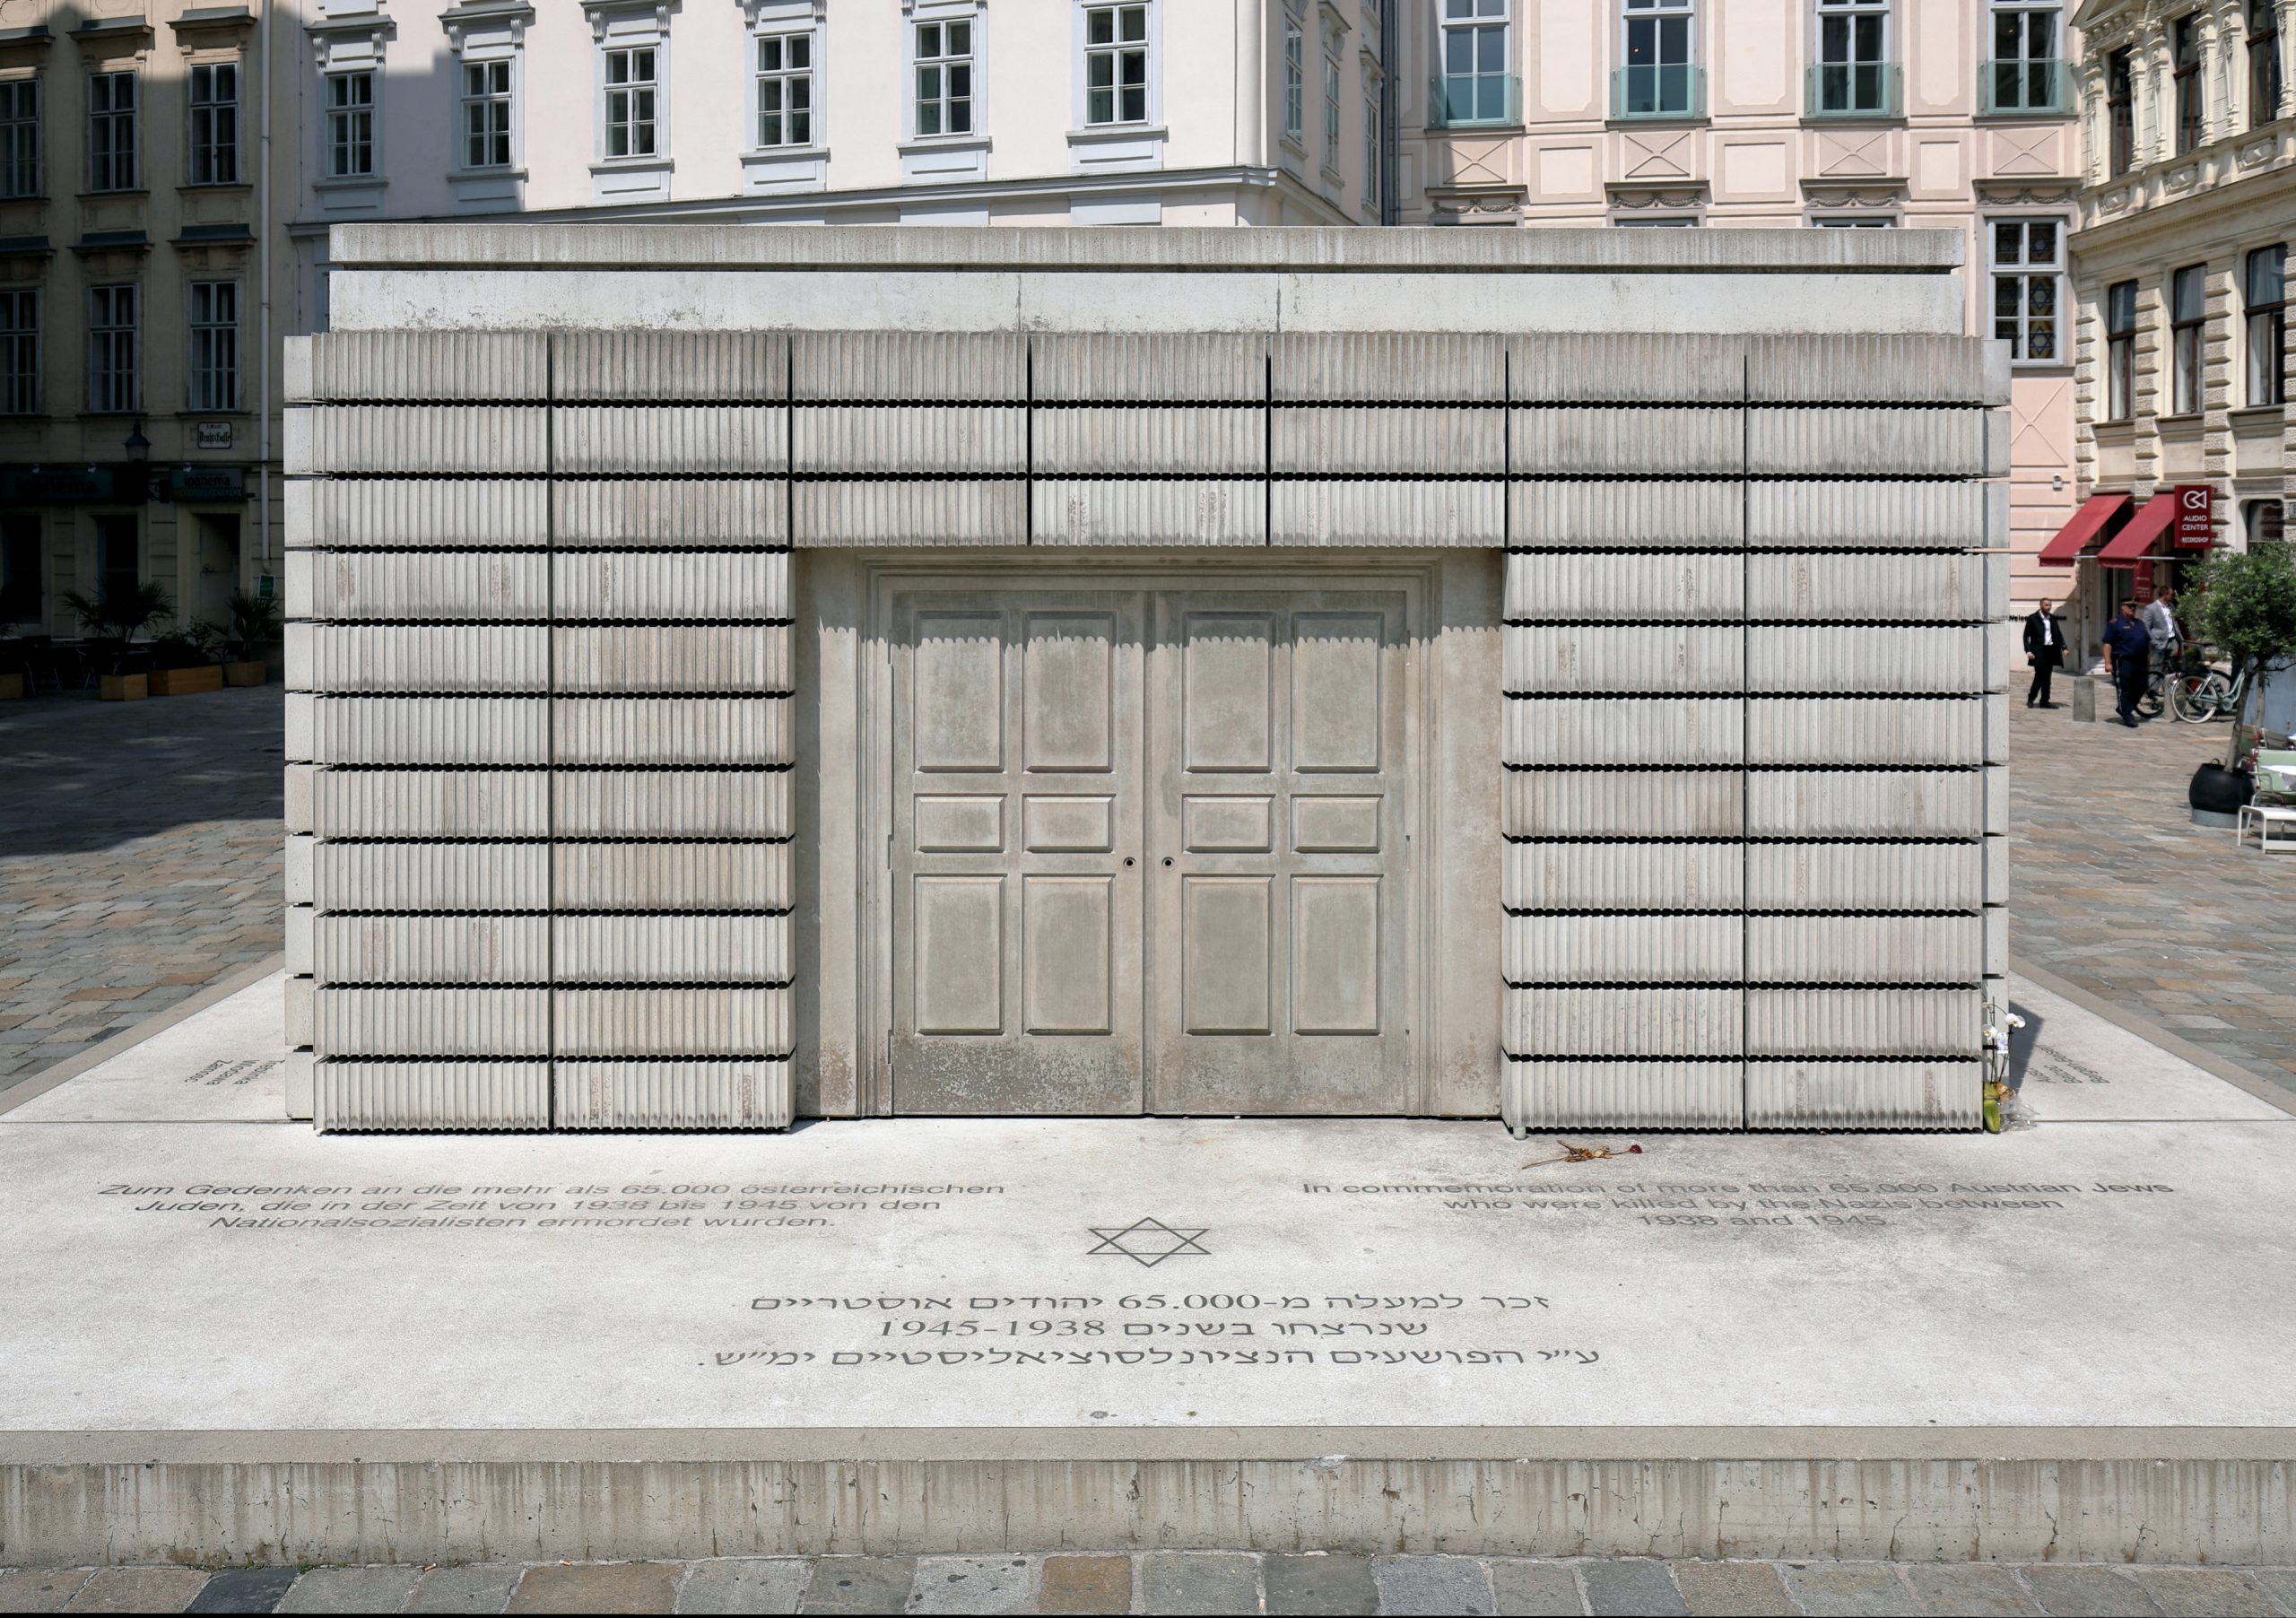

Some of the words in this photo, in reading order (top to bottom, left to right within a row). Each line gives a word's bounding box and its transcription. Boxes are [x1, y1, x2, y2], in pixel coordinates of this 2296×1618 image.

[98, 1184, 175, 1196] Zum
[185, 1184, 353, 1196] Gedenken
[361, 1186, 404, 1196] an
[413, 1184, 463, 1196] die
[472, 1184, 558, 1195] mehr
[565, 1184, 612, 1195] als
[622, 1184, 732, 1195] 65.000
[741, 1181, 1005, 1195] österreichischen
[1302, 1182, 1333, 1194] In
[1343, 1182, 1608, 1194] commemoration
[1618, 1182, 1647, 1194] of
[1657, 1183, 1742, 1194] more
[1748, 1182, 1821, 1194] than
[1951, 1182, 2083, 1194] Austrian
[2092, 1182, 2175, 1194] Jews
[135, 1200, 246, 1212] Juden,
[260, 1200, 313, 1211] die
[321, 1200, 352, 1211] in
[361, 1200, 419, 1211] der
[424, 1200, 490, 1211] Zeit
[500, 1202, 558, 1211] von
[575, 1200, 650, 1211] 1938
[659, 1200, 708, 1211] bis
[724, 1200, 798, 1211] 1945
[810, 1202, 869, 1211] von
[880, 1200, 942, 1211] den
[1443, 1197, 1513, 1210] who
[1522, 1200, 1603, 1210] were
[1611, 1198, 1700, 1209] killed
[1708, 1198, 1747, 1213] by
[1758, 1198, 1812, 1209] the
[1819, 1198, 1913, 1209] Nazis
[1918, 1198, 2066, 1210] between
[209, 1216, 527, 1229] Nationalsozialisten
[537, 1216, 694, 1228] ermordet
[704, 1216, 836, 1228] wurden.
[1637, 1214, 1720, 1227] 1938
[1730, 1214, 1795, 1227] and
[751, 1296, 953, 1311] אוסטריים
[970, 1296, 1105, 1310] יהודים
[1325, 1292, 1465, 1309] למעלה
[1482, 1294, 1551, 1309] זכר
[1123, 1321, 1257, 1336] בשנים
[1272, 1321, 1430, 1336] שנרצחו
[1329, 1349, 1526, 1365] הפושעים
